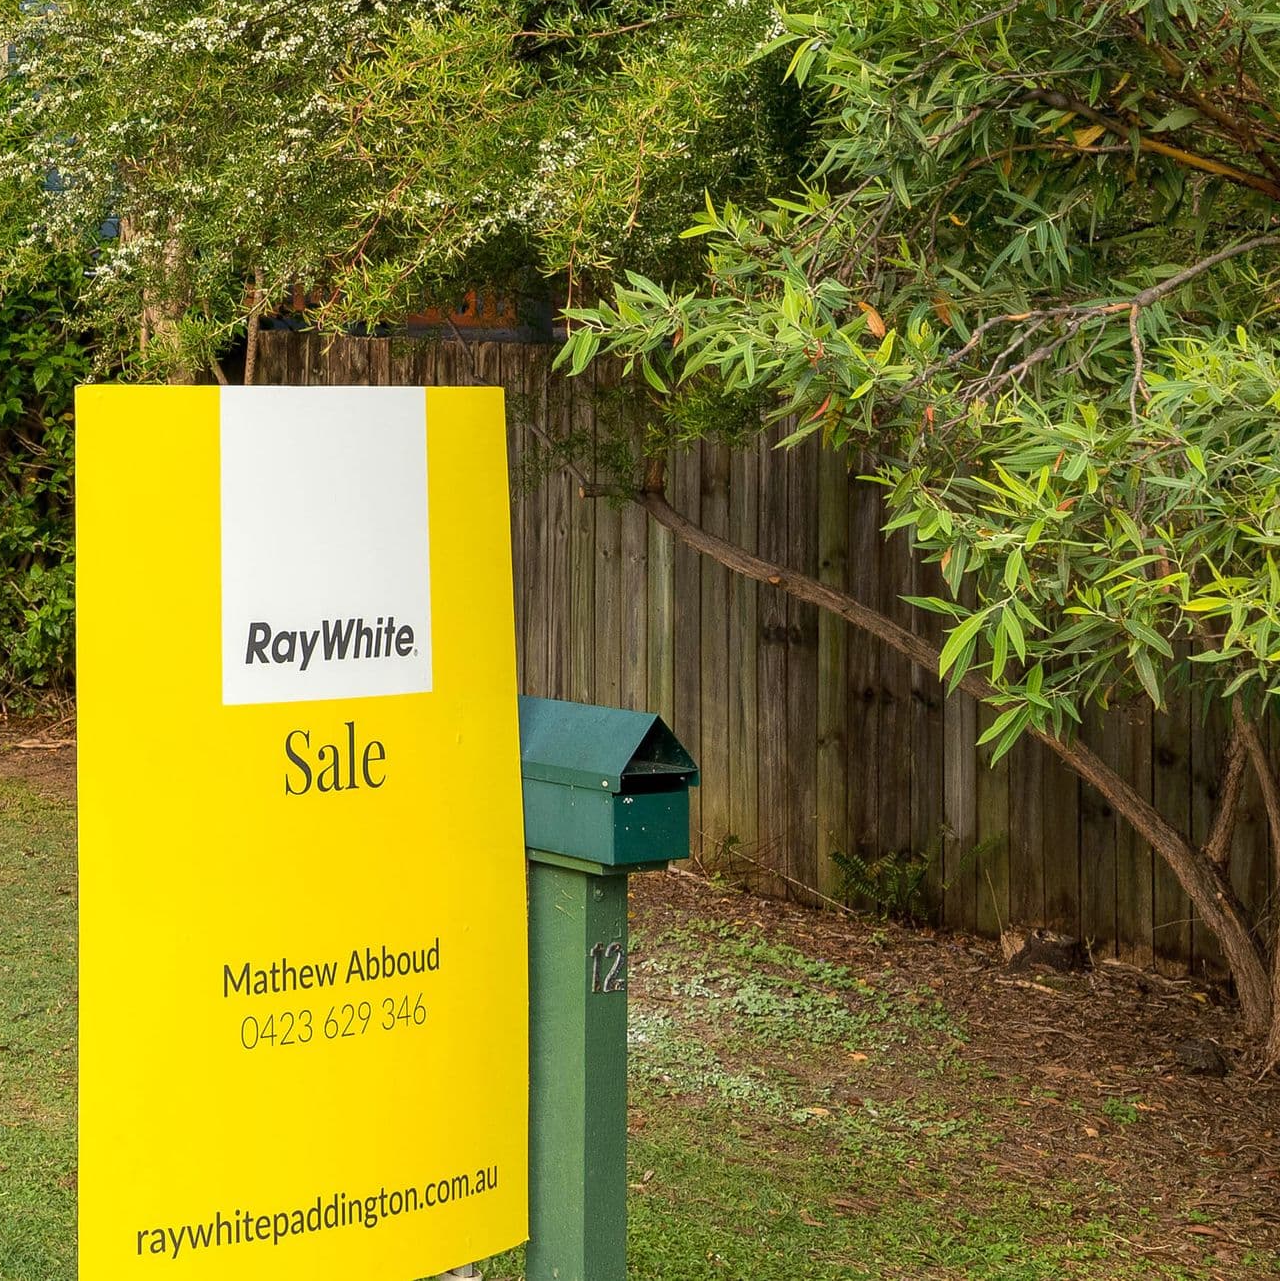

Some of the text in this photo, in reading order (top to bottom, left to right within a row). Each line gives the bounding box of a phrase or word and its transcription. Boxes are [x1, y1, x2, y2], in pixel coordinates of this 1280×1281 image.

[285, 720, 386, 796] Sale
[223, 936, 440, 998] Mathew Abboud
[590, 942, 625, 993] 12
[241, 992, 427, 1050] 0423 629 346
[137, 1165, 498, 1260] raywhitepaddington.com.au
